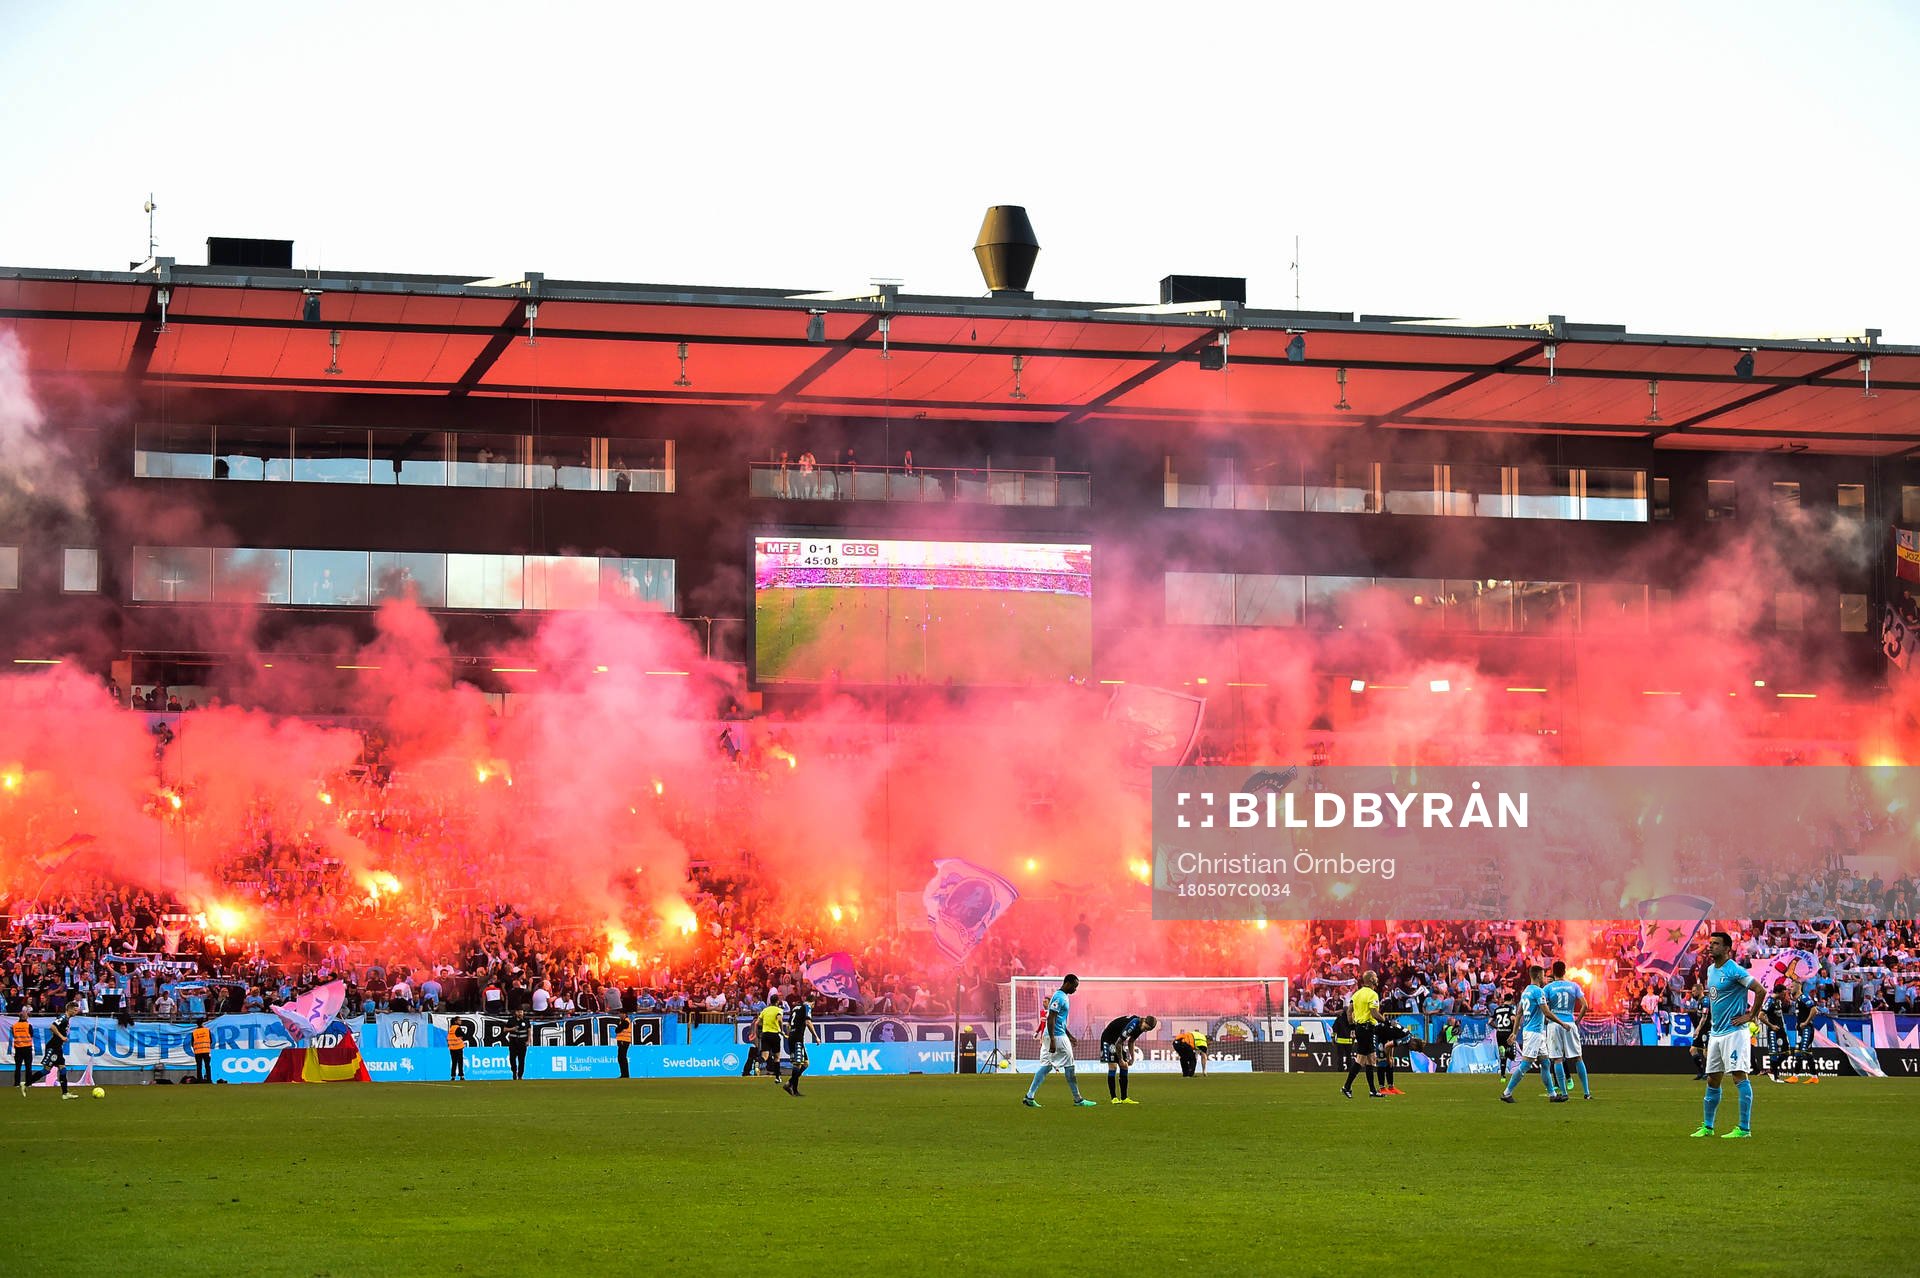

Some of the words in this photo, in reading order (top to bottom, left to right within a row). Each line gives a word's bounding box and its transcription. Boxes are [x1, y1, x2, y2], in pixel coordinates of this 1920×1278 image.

[766, 543, 798, 554] MFF
[842, 545, 878, 555] GBG
[803, 557, 839, 566] 45:08
[1496, 1013, 1511, 1028] 26
[828, 1049, 883, 1071] AAK
[1312, 1052, 1332, 1067] Vi
[1730, 1049, 1738, 1061] 4
[662, 1057, 720, 1068] Swedbank
